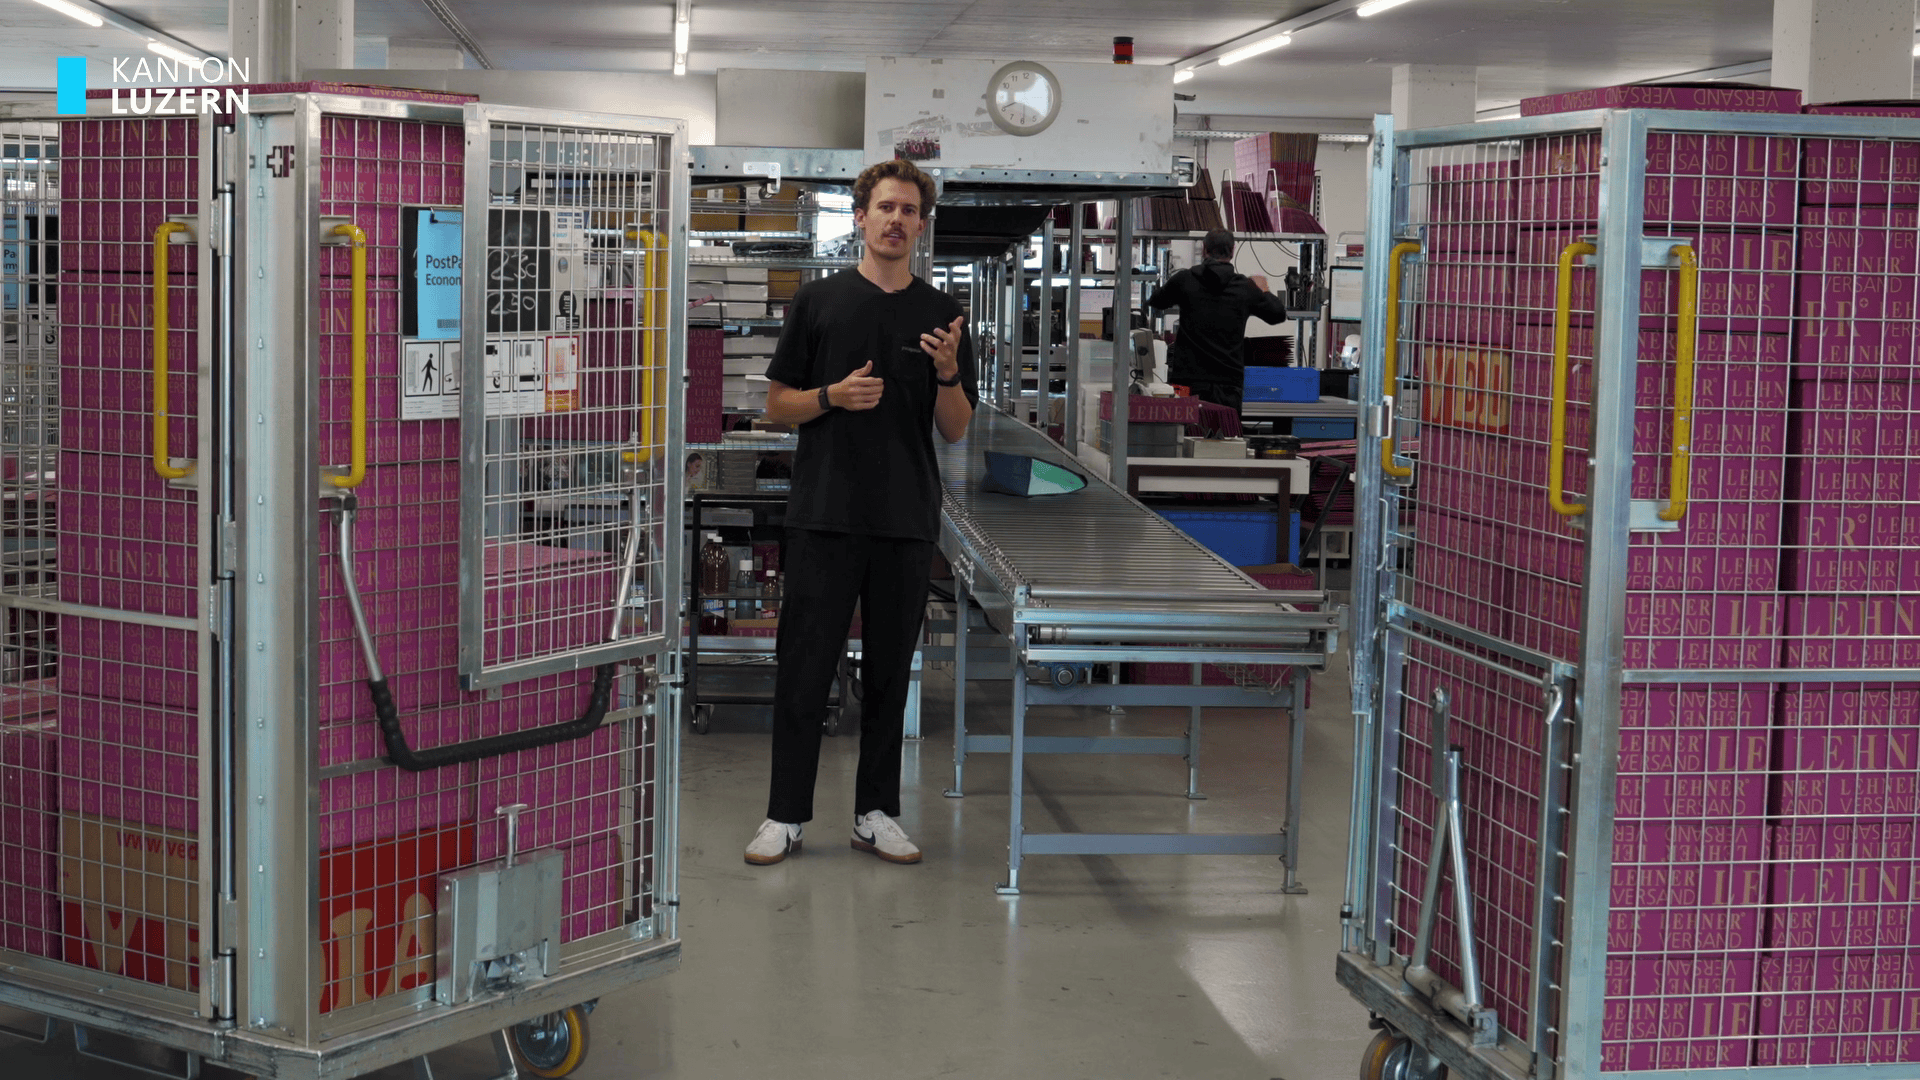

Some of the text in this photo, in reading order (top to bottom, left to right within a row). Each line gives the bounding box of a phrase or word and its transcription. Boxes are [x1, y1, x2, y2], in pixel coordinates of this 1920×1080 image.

[1022, 72, 1030, 80] 12
[1605, 87, 1676, 105] VERSAND
[1693, 88, 1779, 107] VERSAND
[1692, 179, 1775, 198] LEHNER
[1692, 199, 1776, 218] VERSAND
[1820, 276, 1902, 293] VERSAND
[1820, 384, 1902, 402] LEHNER
[1820, 403, 1904, 421] VERSAND
[1727, 468, 1780, 487] LEHN
[1819, 472, 1900, 490] LEHNER
[1818, 491, 1901, 509] VERSAND
[1803, 516, 1859, 553] ER
[1721, 557, 1775, 575] LEHN
[1815, 560, 1897, 577] LEHNER
[1627, 597, 1711, 616] LEHNER
[1627, 616, 1711, 635] VERSAND
[1675, 643, 1758, 661] LEHNER
[1668, 691, 1752, 709] VERSAND
[1619, 734, 1700, 752] LEHNER
[1716, 735, 1769, 772] LE
[1793, 734, 1912, 771] LEHN
[1617, 754, 1700, 771] VERSAND
[1664, 779, 1746, 797] LEHNER
[1663, 799, 1746, 816] VERSAND
[1665, 826, 1748, 843] VERSAND
[1833, 824, 1913, 841] VERSAND
[1613, 869, 1696, 887] LEHNER
[1611, 888, 1696, 906] VERSAND
[1660, 912, 1742, 930] LEHNER
[1659, 931, 1742, 949] VERSAND
[1653, 959, 1737, 976] VERSAND
[1832, 955, 1914, 972] VERSAND
[1603, 1002, 1684, 1020] LEHNER
[1783, 998, 1864, 1017] LEHNER
[1602, 1022, 1685, 1039] VERSAND
[1782, 1017, 1864, 1035] VERSAND
[1648, 1045, 1730, 1063] LEHNER
[1829, 1039, 1909, 1058] LEHNER
